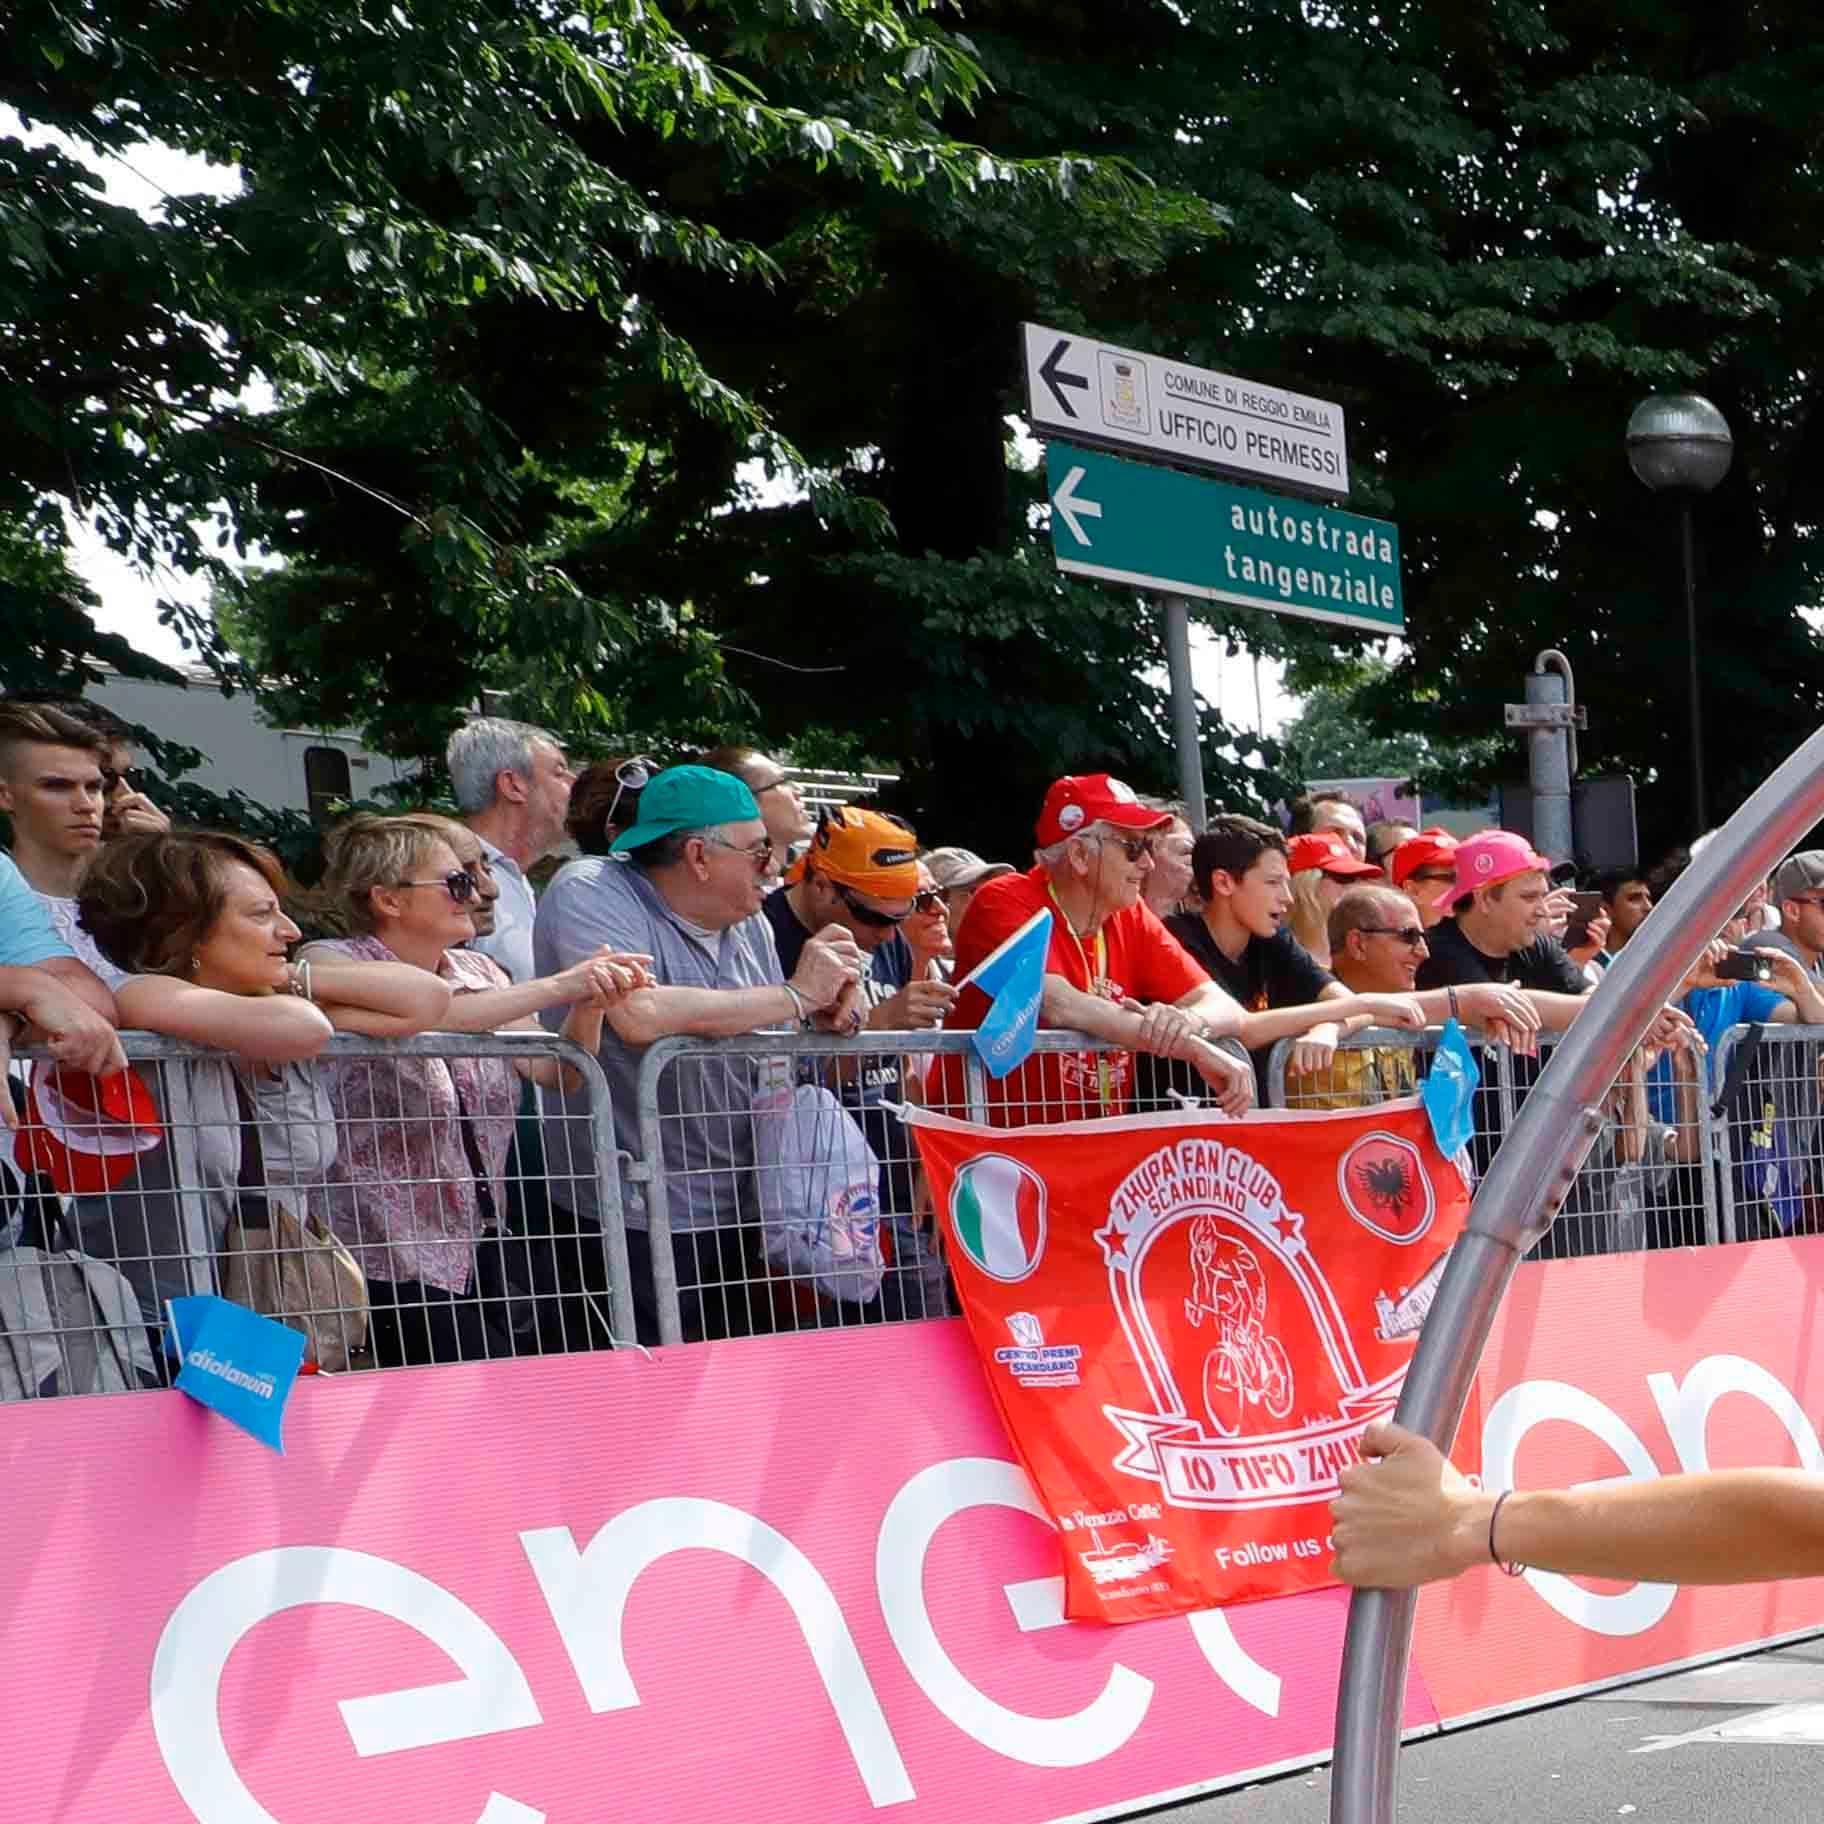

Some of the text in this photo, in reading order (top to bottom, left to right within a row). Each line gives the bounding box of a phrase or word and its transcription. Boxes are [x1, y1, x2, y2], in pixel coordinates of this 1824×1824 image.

[1164, 371, 1331, 429] COMUNE DI REGGIO EMILIA
[1159, 410, 1341, 475] UFFICIO PERMESSI
[1231, 504, 1394, 563] autostrada
[1224, 545, 1395, 609] tangenziale
[1115, 1145, 1281, 1219] ZHUPA FAN CLUB
[1149, 1176, 1247, 1218] SCANDIANO
[1181, 1454, 1218, 1491] IO
[1223, 1452, 1296, 1491] TIFO
[1216, 1541, 1288, 1569] Follow
[1295, 1541, 1321, 1558] us
